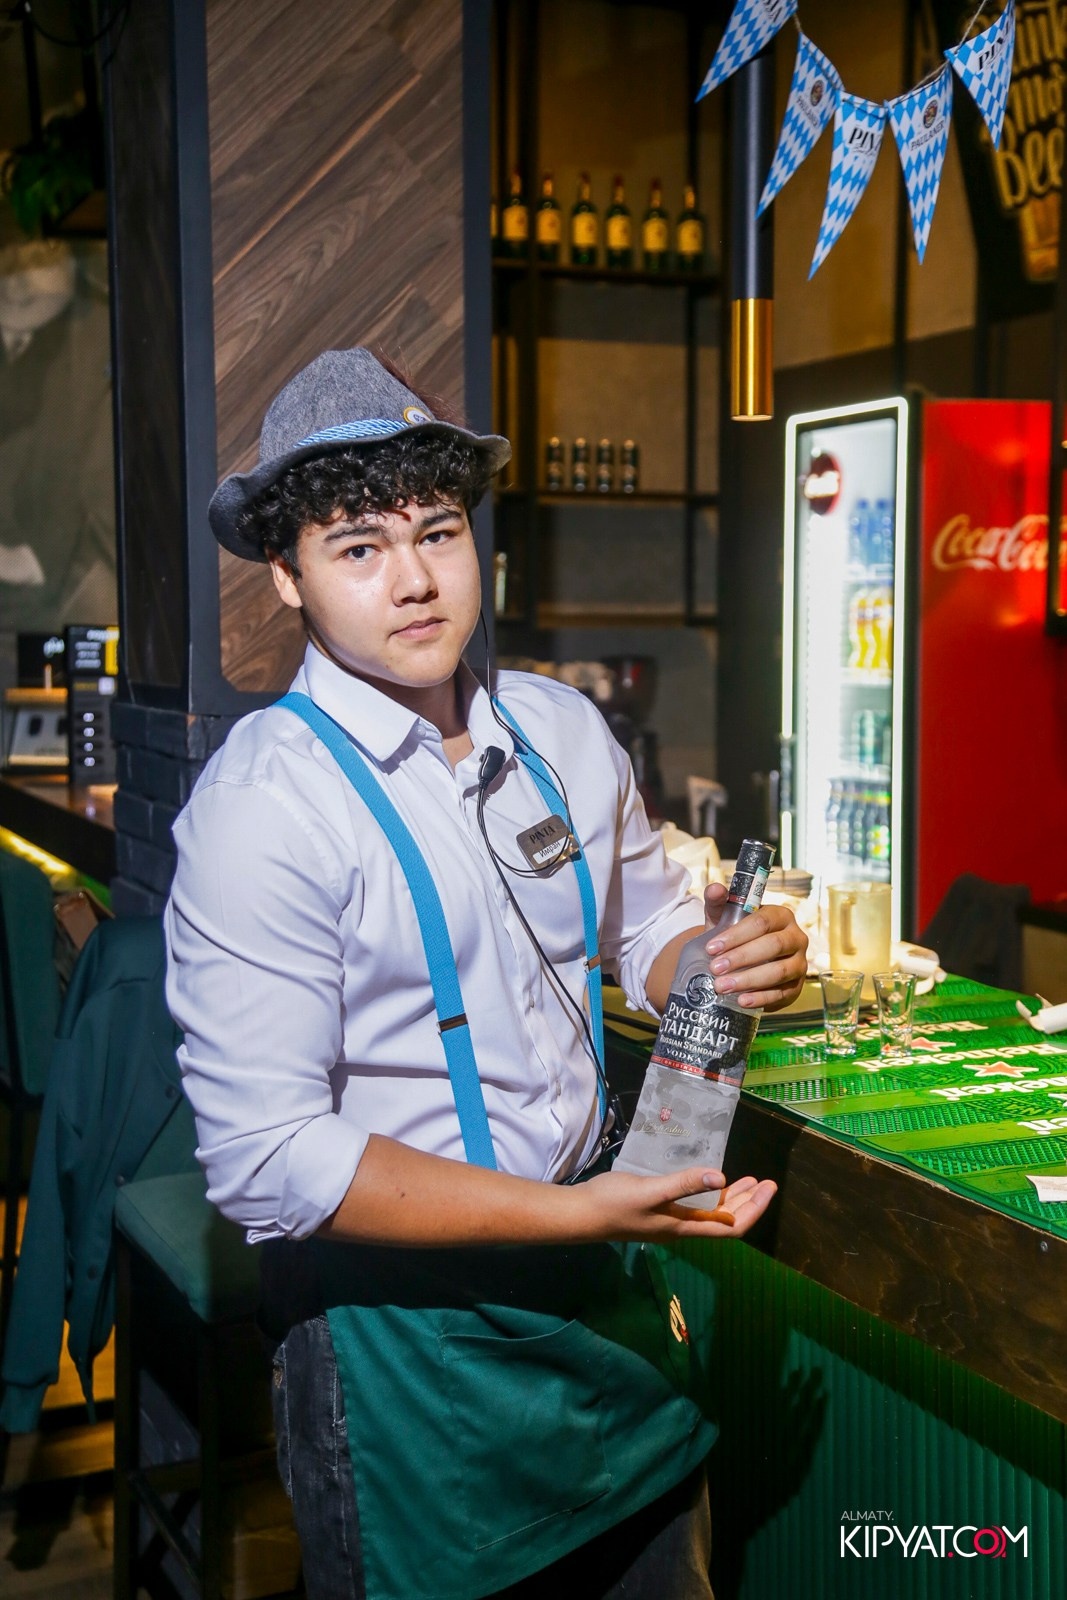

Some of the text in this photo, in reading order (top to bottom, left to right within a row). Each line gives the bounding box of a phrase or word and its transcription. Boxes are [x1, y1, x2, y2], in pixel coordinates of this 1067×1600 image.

[910, 119, 945, 151] PAULANER
[528, 824, 557, 844] PINTA
[659, 1014, 739, 1051] СТАНДАРТ
[660, 1034, 723, 1059] RUSSIAN STANDARD
[666, 1048, 702, 1064] VODKA
[852, 1043, 1067, 1072] Heineken
[664, 1060, 698, 1073] ORIGINAL
[929, 1076, 1067, 1101] neken
